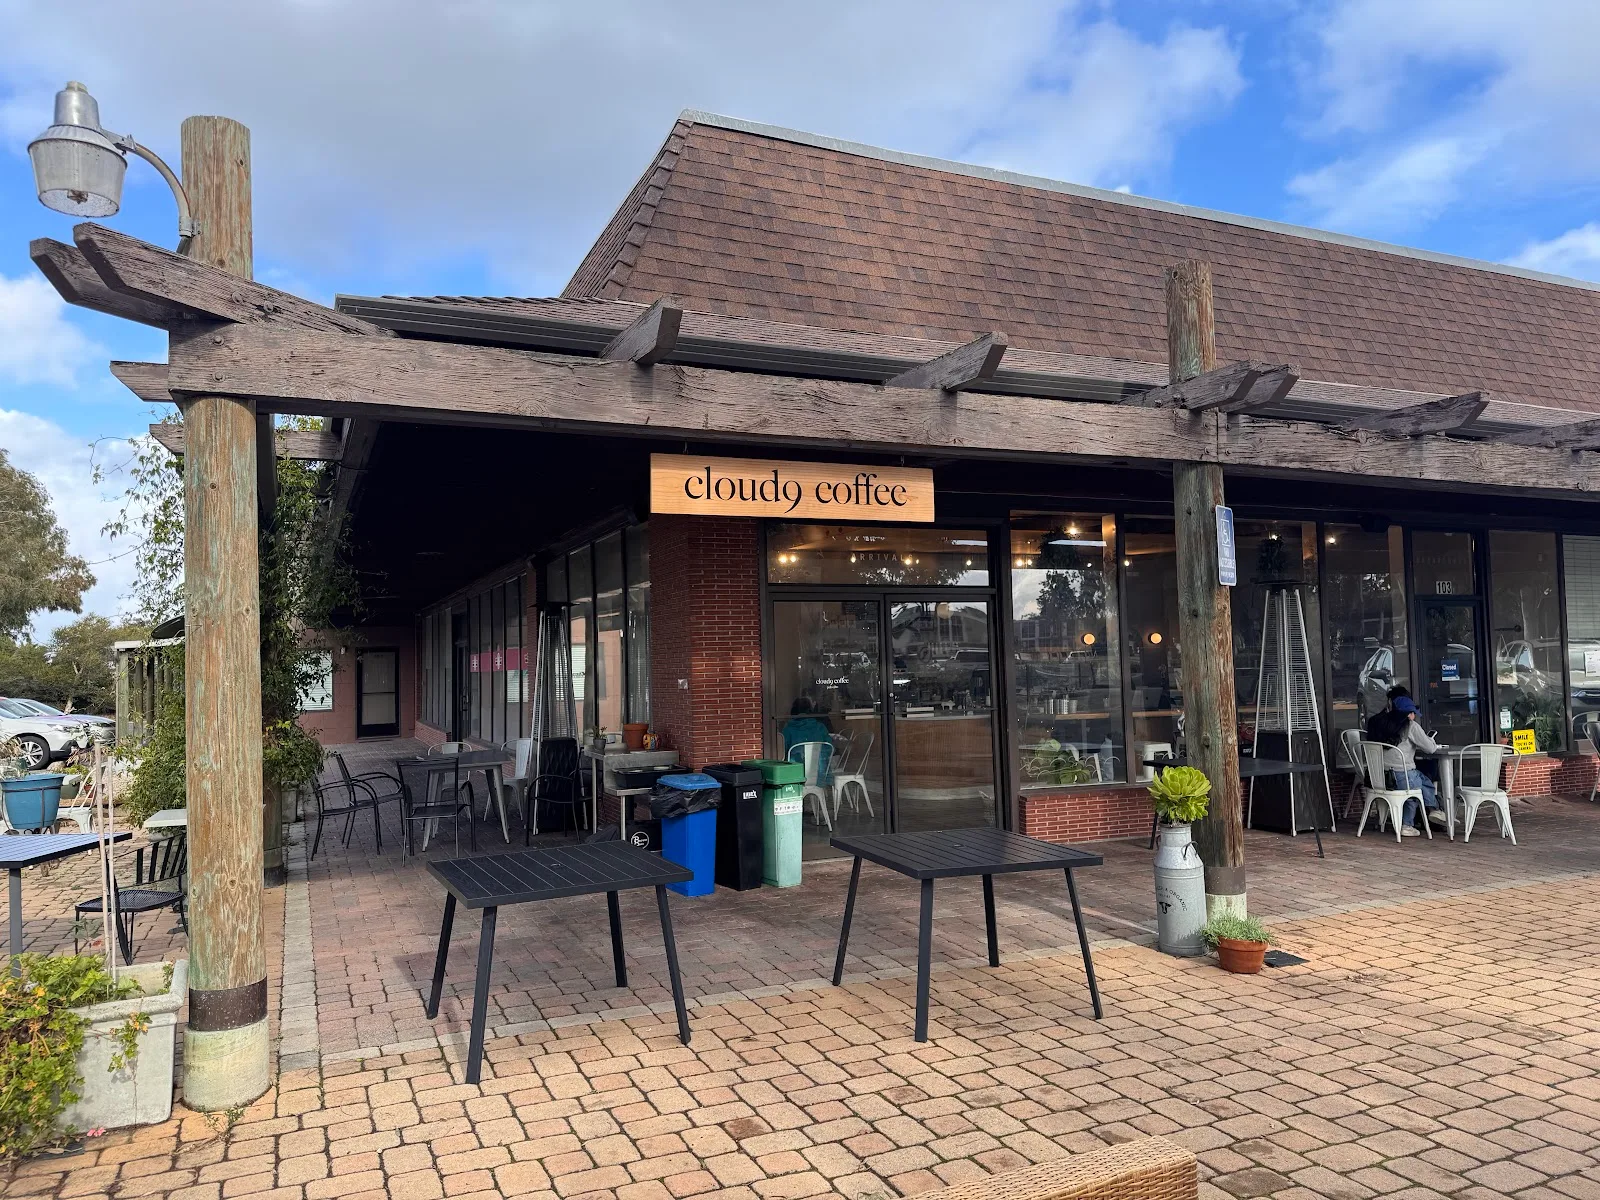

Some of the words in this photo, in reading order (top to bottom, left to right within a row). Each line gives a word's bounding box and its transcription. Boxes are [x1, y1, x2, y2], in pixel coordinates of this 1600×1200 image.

[684, 466, 802, 513] cloud9
[815, 472, 907, 506] coffee
[1437, 581, 1452, 594] 103
